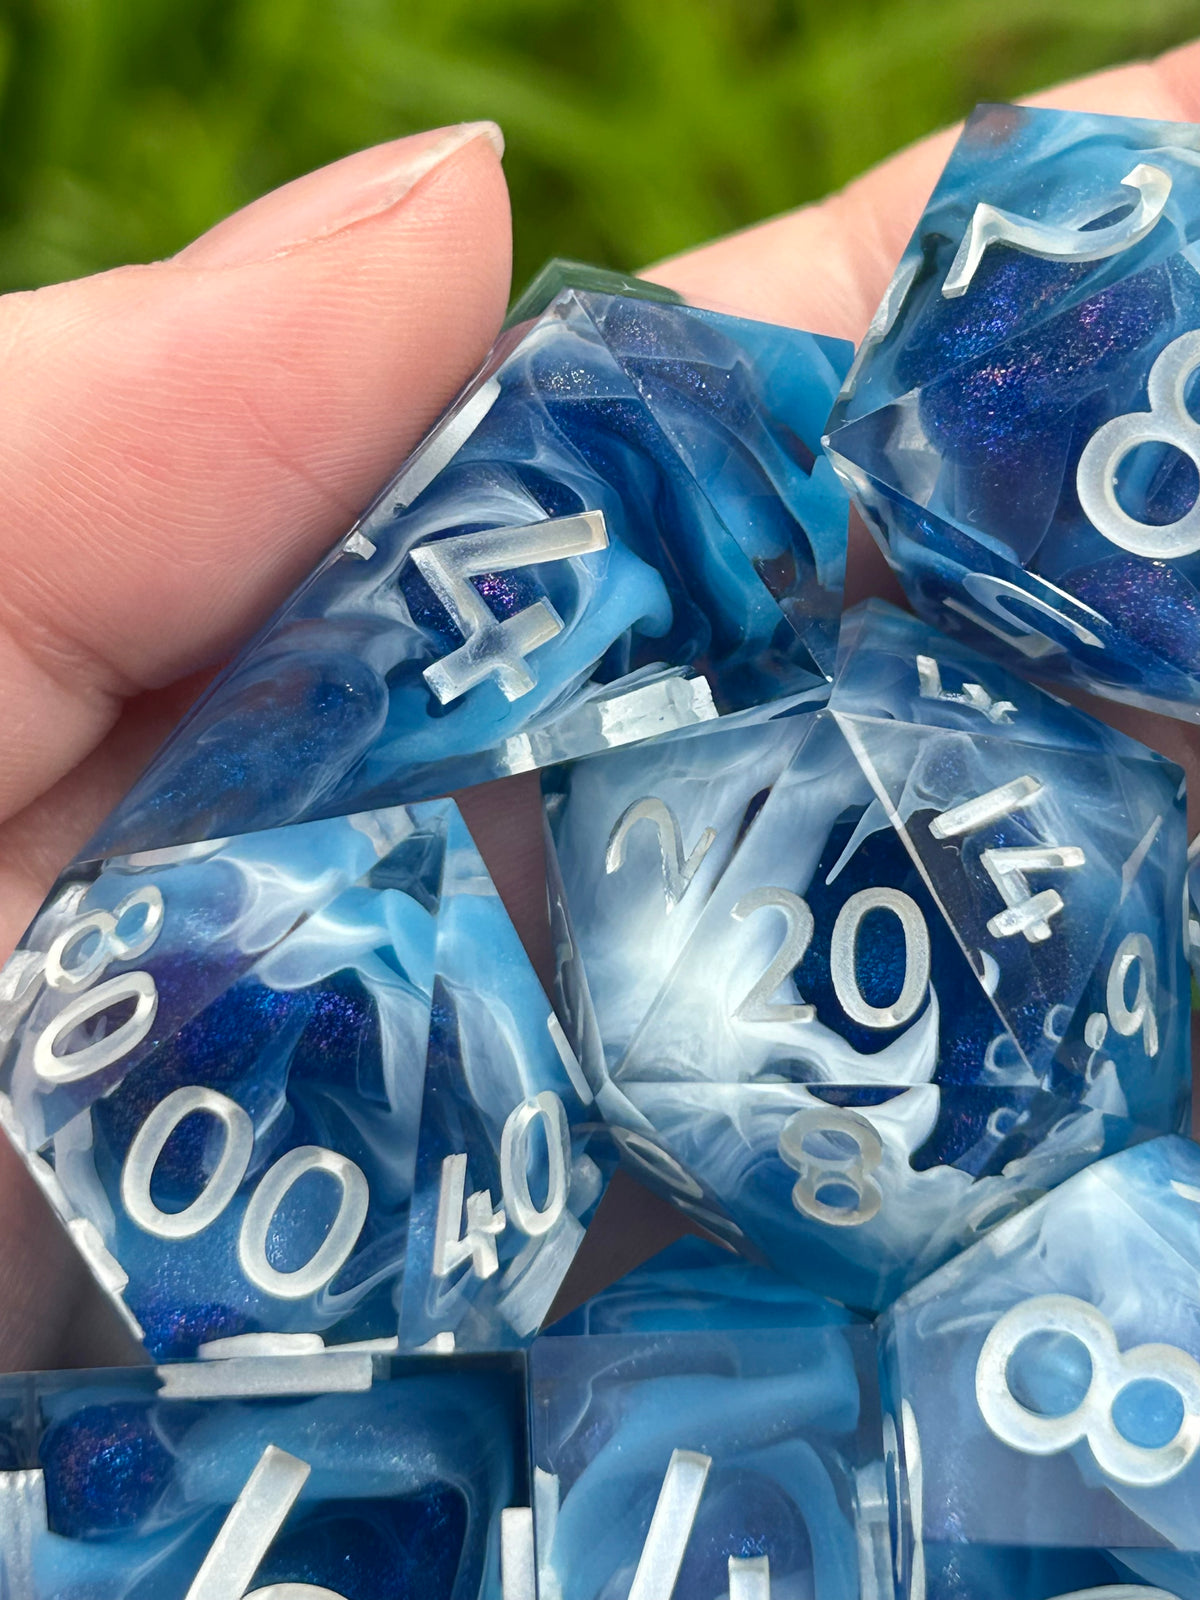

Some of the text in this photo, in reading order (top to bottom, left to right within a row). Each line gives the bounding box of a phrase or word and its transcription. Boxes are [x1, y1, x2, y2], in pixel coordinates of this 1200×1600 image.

[942, 163, 1172, 298] 2
[1077, 329, 1200, 559] 8
[410, 509, 610, 705] 4
[605, 796, 718, 915] 2
[928, 773, 1086, 943] 14
[730, 886, 931, 1029] 20
[121, 1085, 369, 1299] 00
[432, 1090, 571, 1280] 40
[779, 1105, 883, 1227] 8
[975, 1293, 1200, 1487] 8
